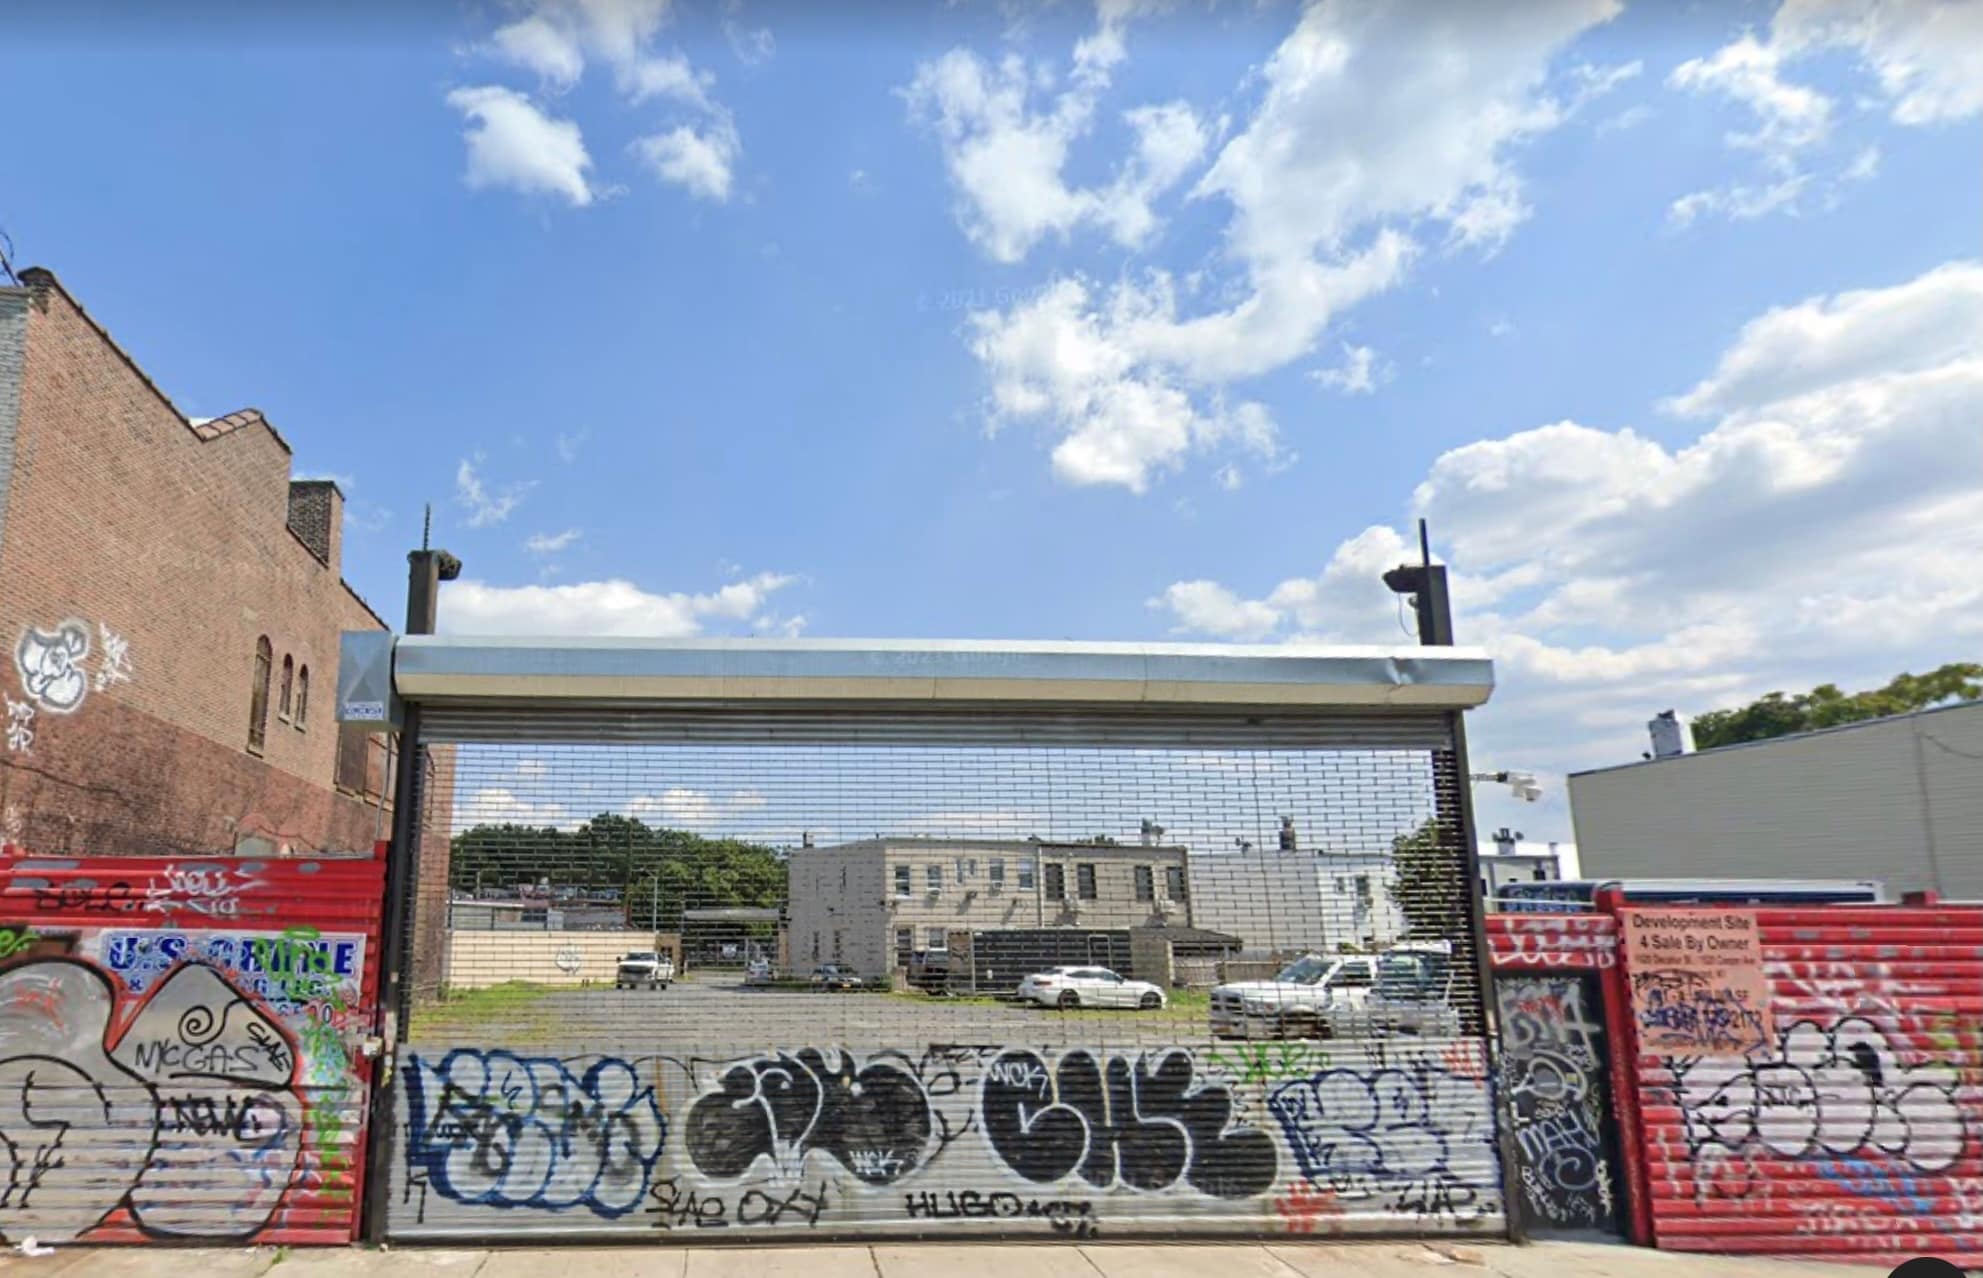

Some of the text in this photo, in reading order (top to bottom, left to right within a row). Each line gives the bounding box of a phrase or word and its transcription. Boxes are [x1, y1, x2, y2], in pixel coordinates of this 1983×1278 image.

[1632, 914, 1750, 932] Development Site
[1640, 935, 1749, 952] 4 Sale By Owner
[905, 1190, 1023, 1218] HUGO
